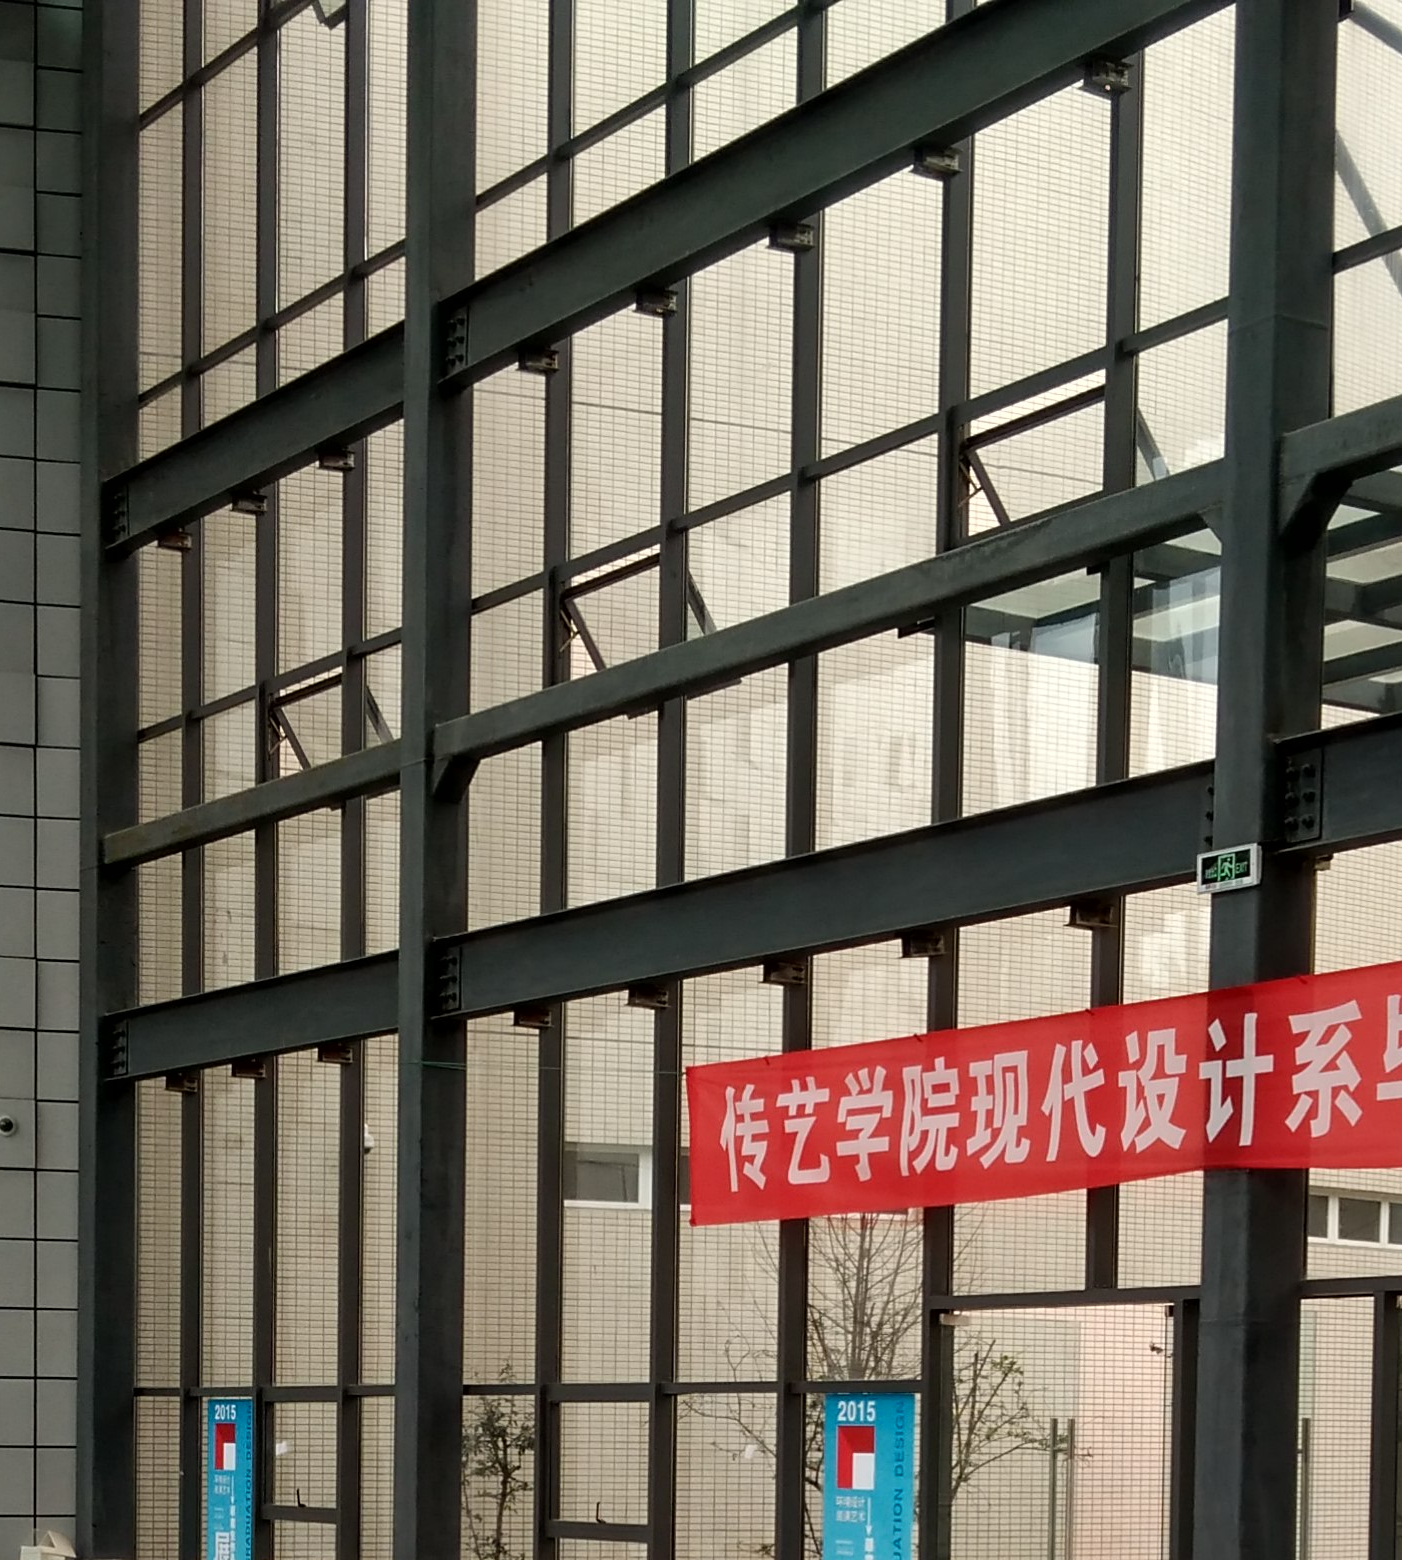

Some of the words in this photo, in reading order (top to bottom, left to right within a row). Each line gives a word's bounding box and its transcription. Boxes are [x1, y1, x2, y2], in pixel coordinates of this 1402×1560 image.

[1235, 861, 1248, 874] EXIT
[214, 1404, 237, 1420] 2015
[837, 1400, 876, 1422] 2015
[894, 1401, 905, 1477] DESIGN
